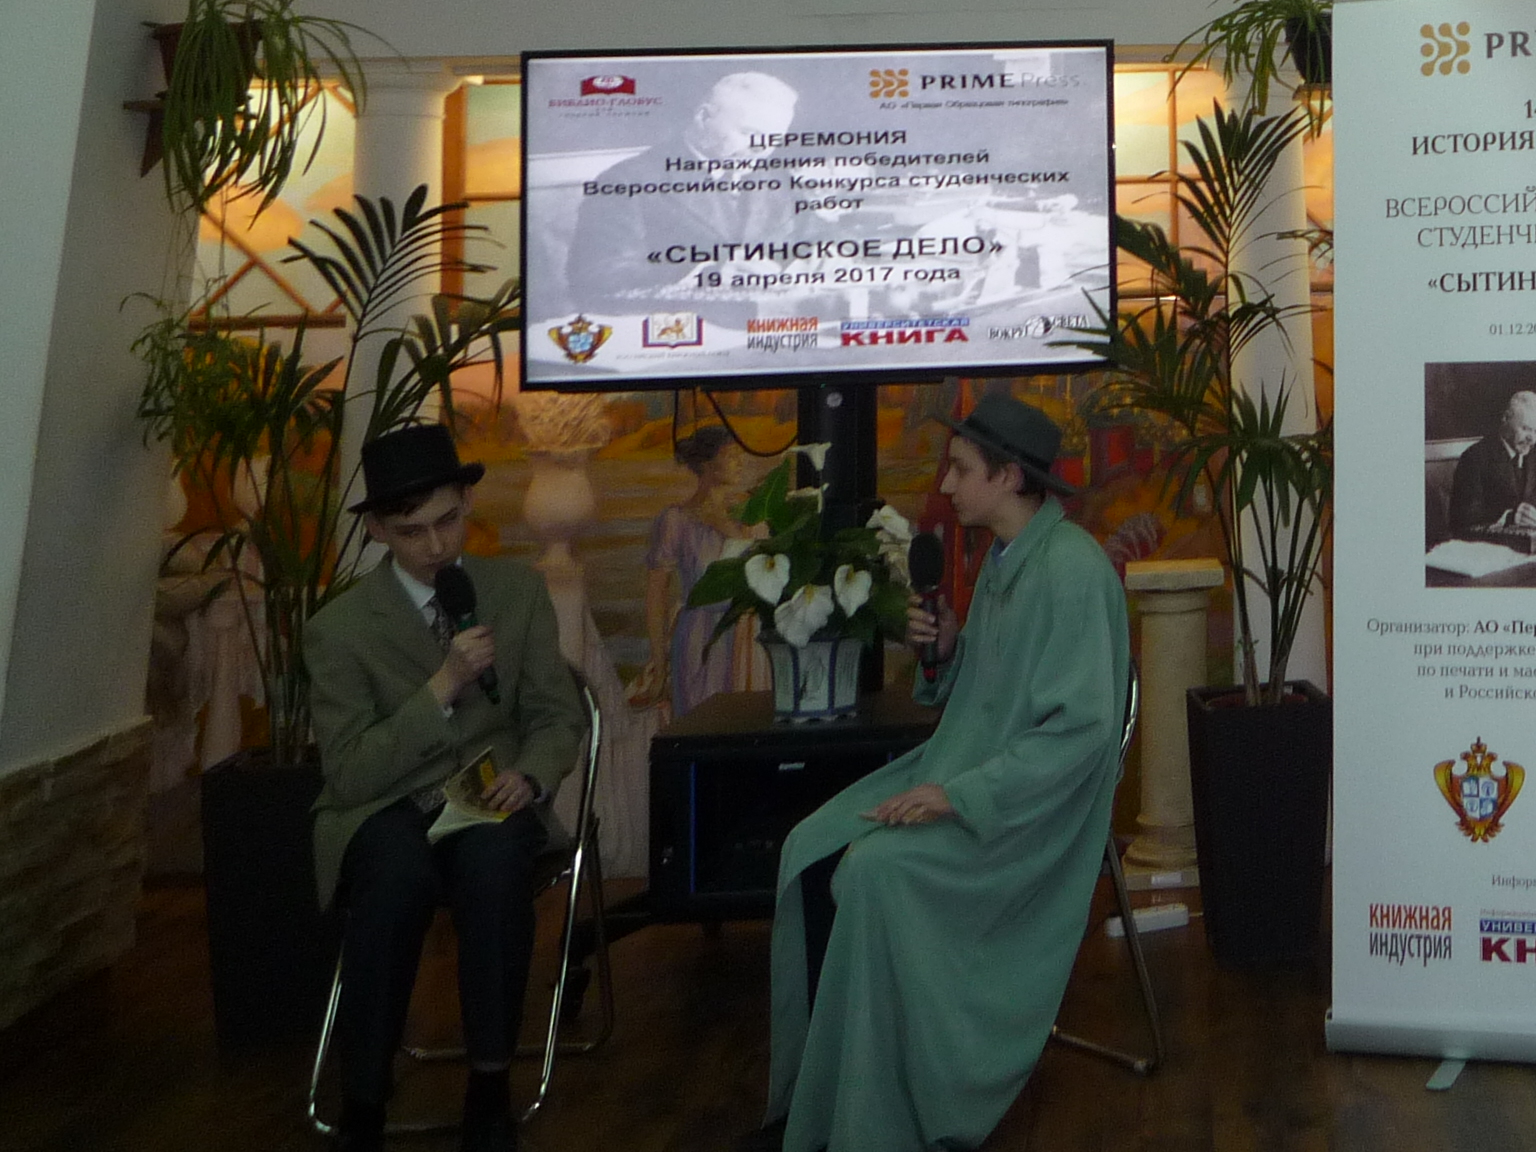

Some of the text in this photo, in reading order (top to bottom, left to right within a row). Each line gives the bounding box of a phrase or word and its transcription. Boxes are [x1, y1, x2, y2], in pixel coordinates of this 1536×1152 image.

[920, 73, 1016, 90] PRIME
[749, 130, 908, 149] ЦЕРЕМОНИЯ
[1411, 130, 1535, 156] ИСТОРИЯ
[665, 149, 990, 173] Награждения победителей
[583, 171, 1070, 198] Всероссийского Конкурса студенческих
[794, 195, 865, 214] работ
[647, 236, 1005, 264] «СЫТИНСКОЕ ДЕЛО»
[694, 266, 962, 290] 19 апреля 2017 года
[840, 328, 970, 346] КНИГА
[1366, 618, 1469, 637] Организатор:
[1474, 619, 1499, 635] АО
[1413, 642, 1443, 659] при
[1447, 643, 1536, 659] поддержке
[1416, 665, 1436, 678] по
[1440, 665, 1494, 678] печати
[1498, 666, 1508, 678] и
[1444, 686, 1454, 699] и
[1369, 903, 1452, 931] книжная
[1369, 932, 1452, 967] индустрия
